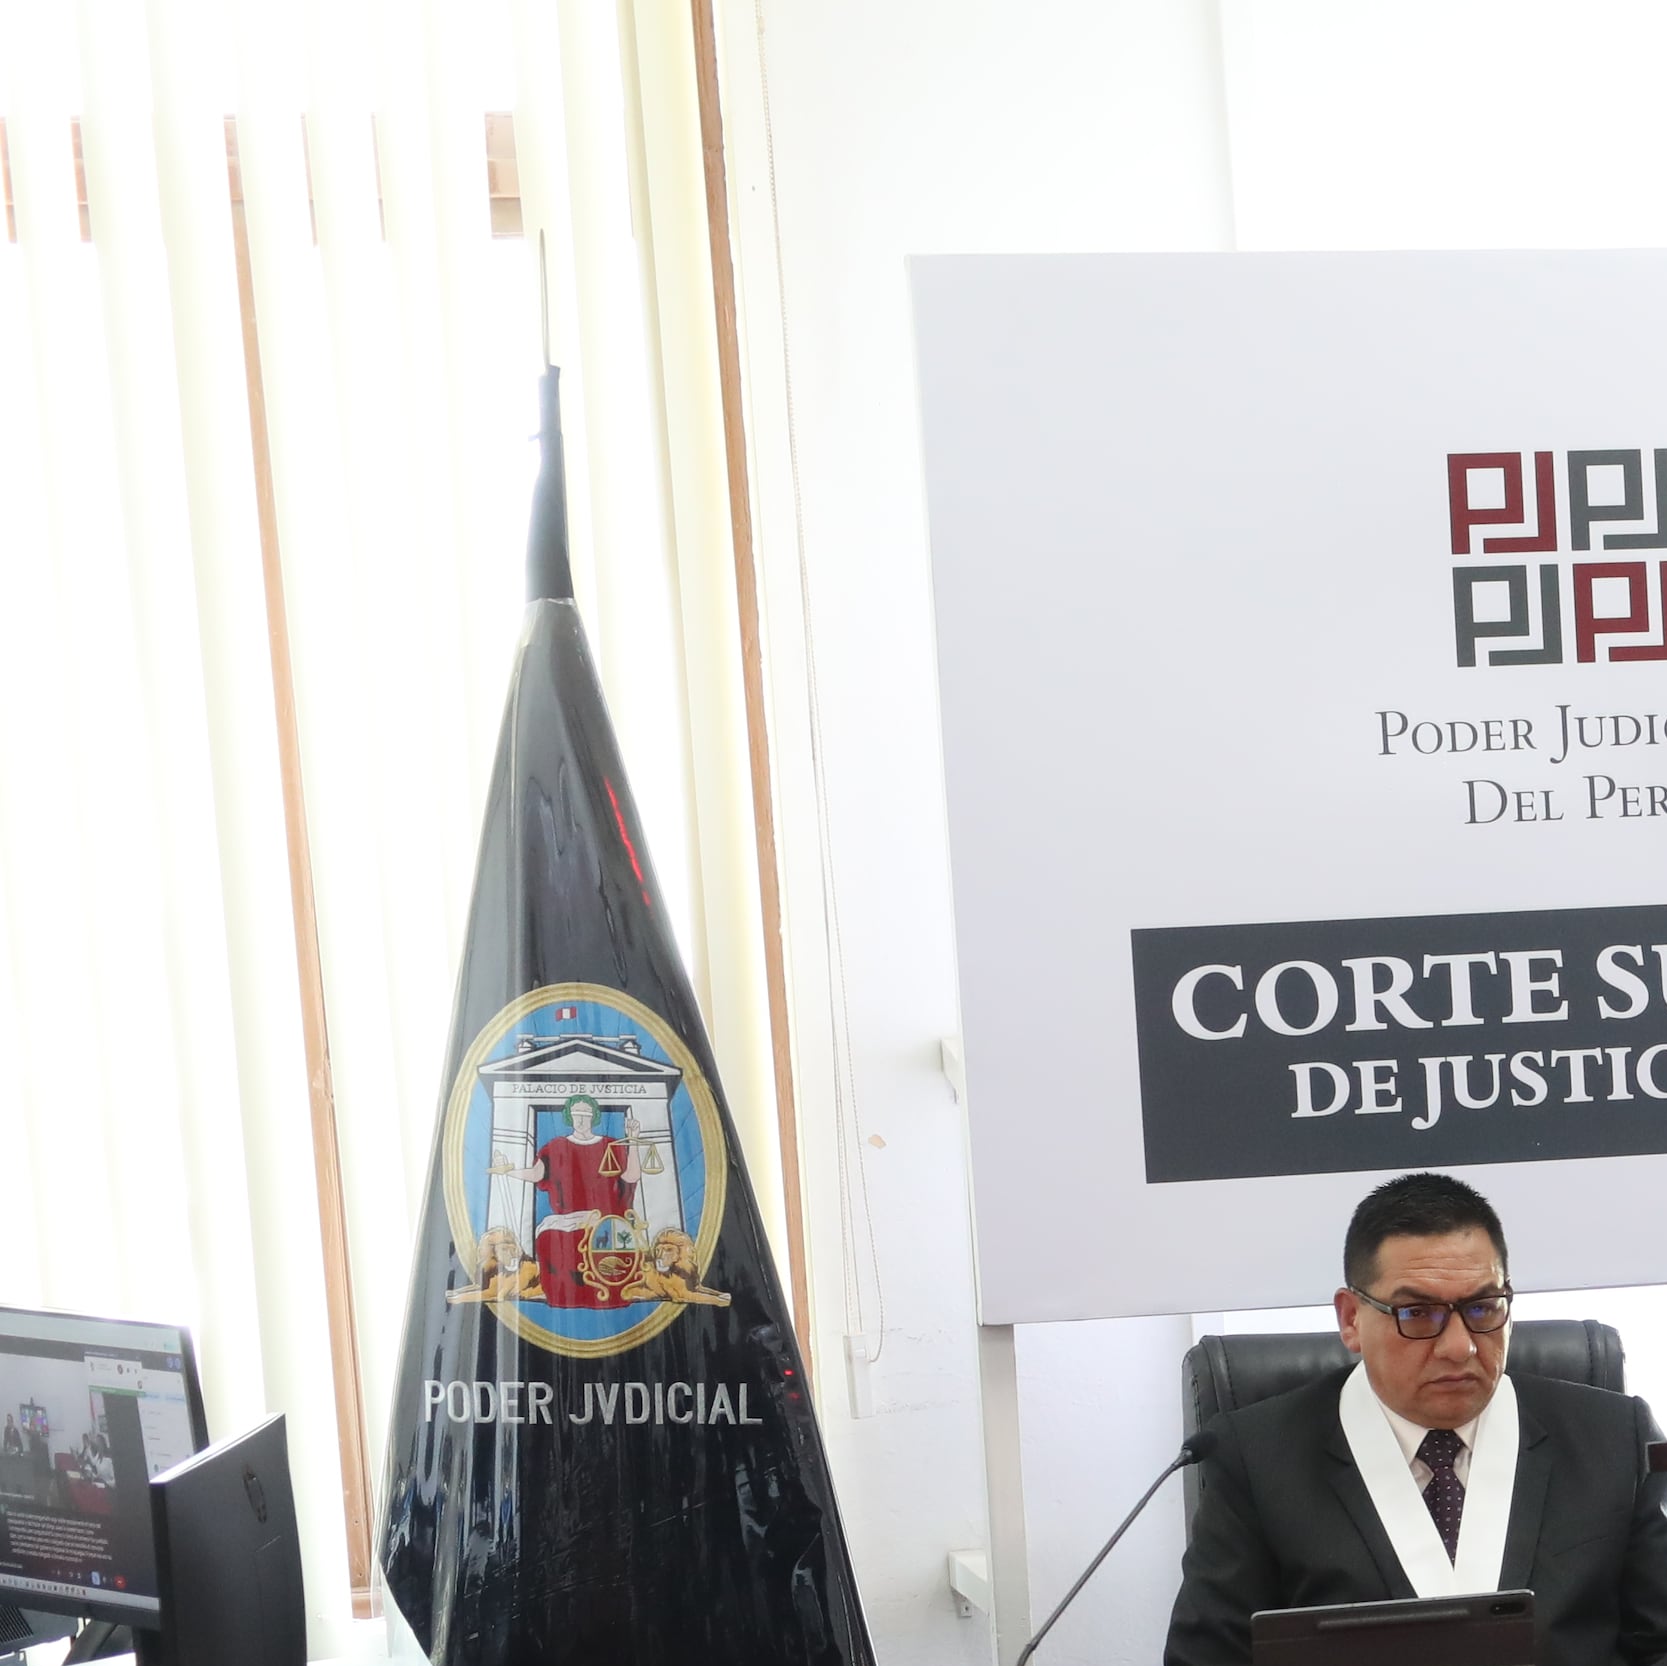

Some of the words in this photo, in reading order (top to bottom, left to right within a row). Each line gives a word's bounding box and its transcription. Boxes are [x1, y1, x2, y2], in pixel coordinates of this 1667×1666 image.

[1171, 949, 1569, 1041] CORTE
[513, 1084, 566, 1094] PALACIO
[570, 1084, 587, 1094] DE
[1288, 1060, 1403, 1119] DE
[424, 1380, 554, 1425] PODER
